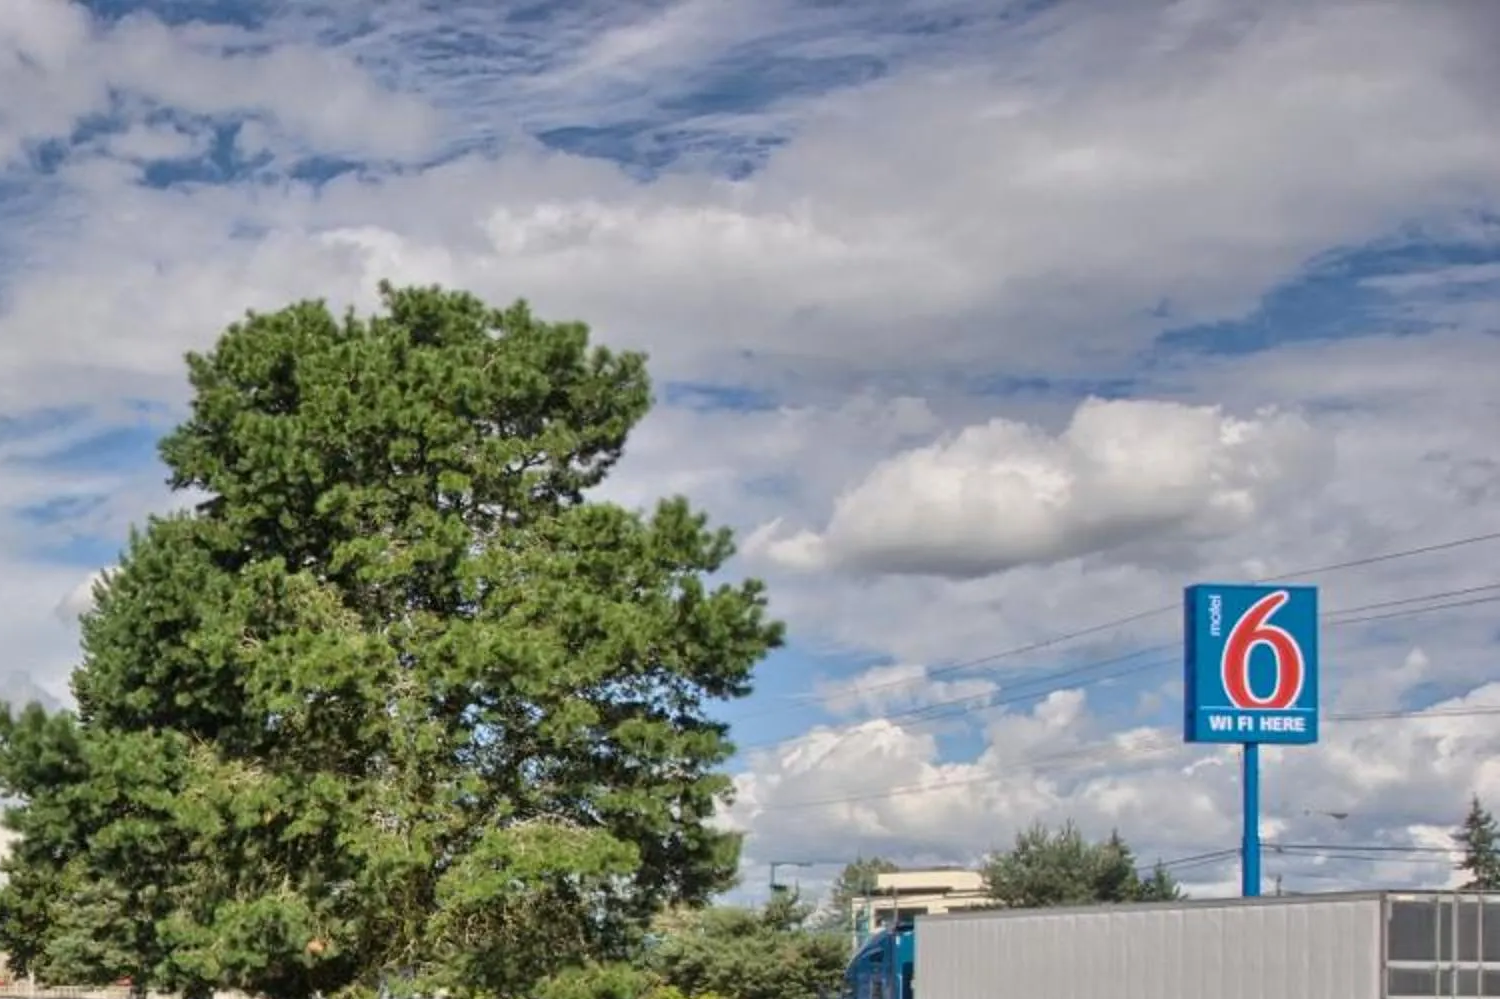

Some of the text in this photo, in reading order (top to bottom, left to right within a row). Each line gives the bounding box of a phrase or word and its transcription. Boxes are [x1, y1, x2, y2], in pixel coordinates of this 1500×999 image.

[1208, 594, 1221, 636] motel
[1221, 590, 1306, 710] 6
[1209, 715, 1306, 732] WI FI HERE
